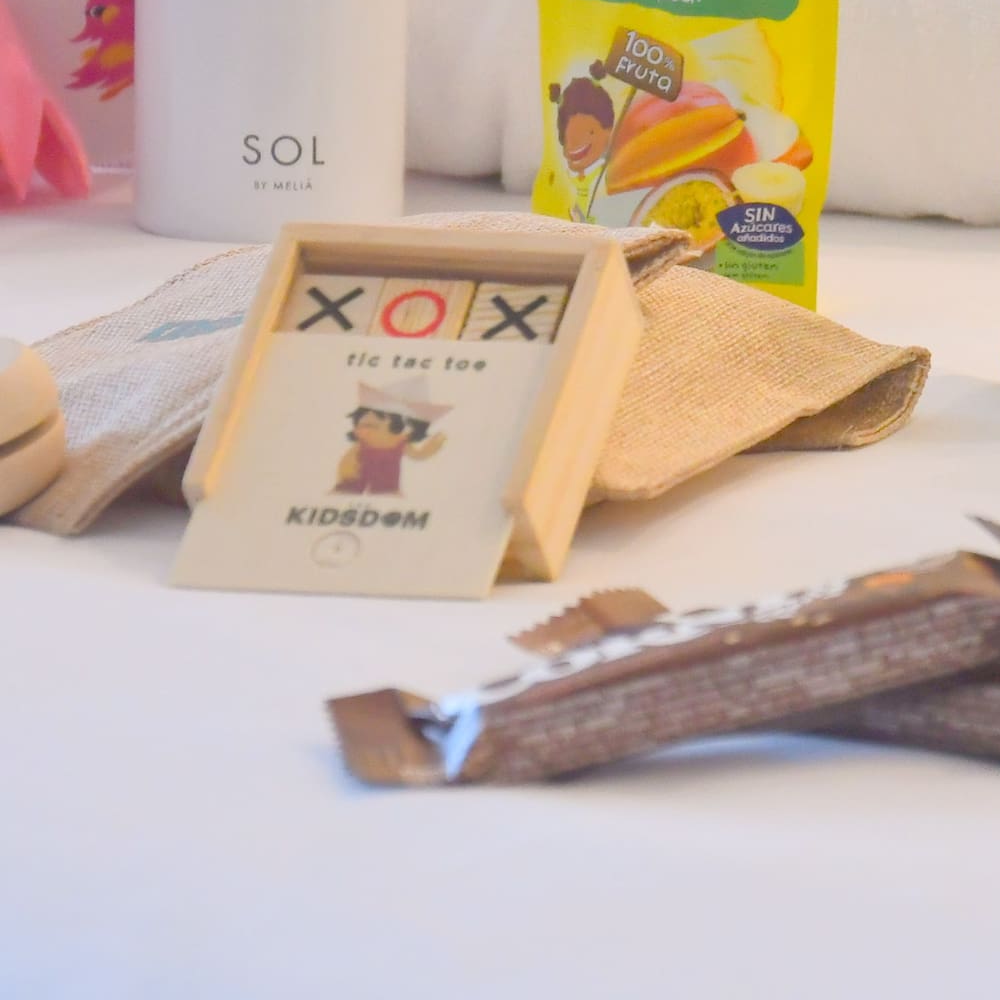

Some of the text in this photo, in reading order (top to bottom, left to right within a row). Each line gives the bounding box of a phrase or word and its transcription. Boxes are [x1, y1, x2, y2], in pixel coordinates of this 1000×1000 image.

[626, 31, 675, 71] 100%
[242, 134, 325, 166] SOL
[254, 181, 267, 191] BY
[744, 207, 776, 223] SIN
[730, 222, 793, 234] Azúcares
[347, 352, 487, 371] tic tac toe
[285, 506, 431, 530] KIDSDOM
